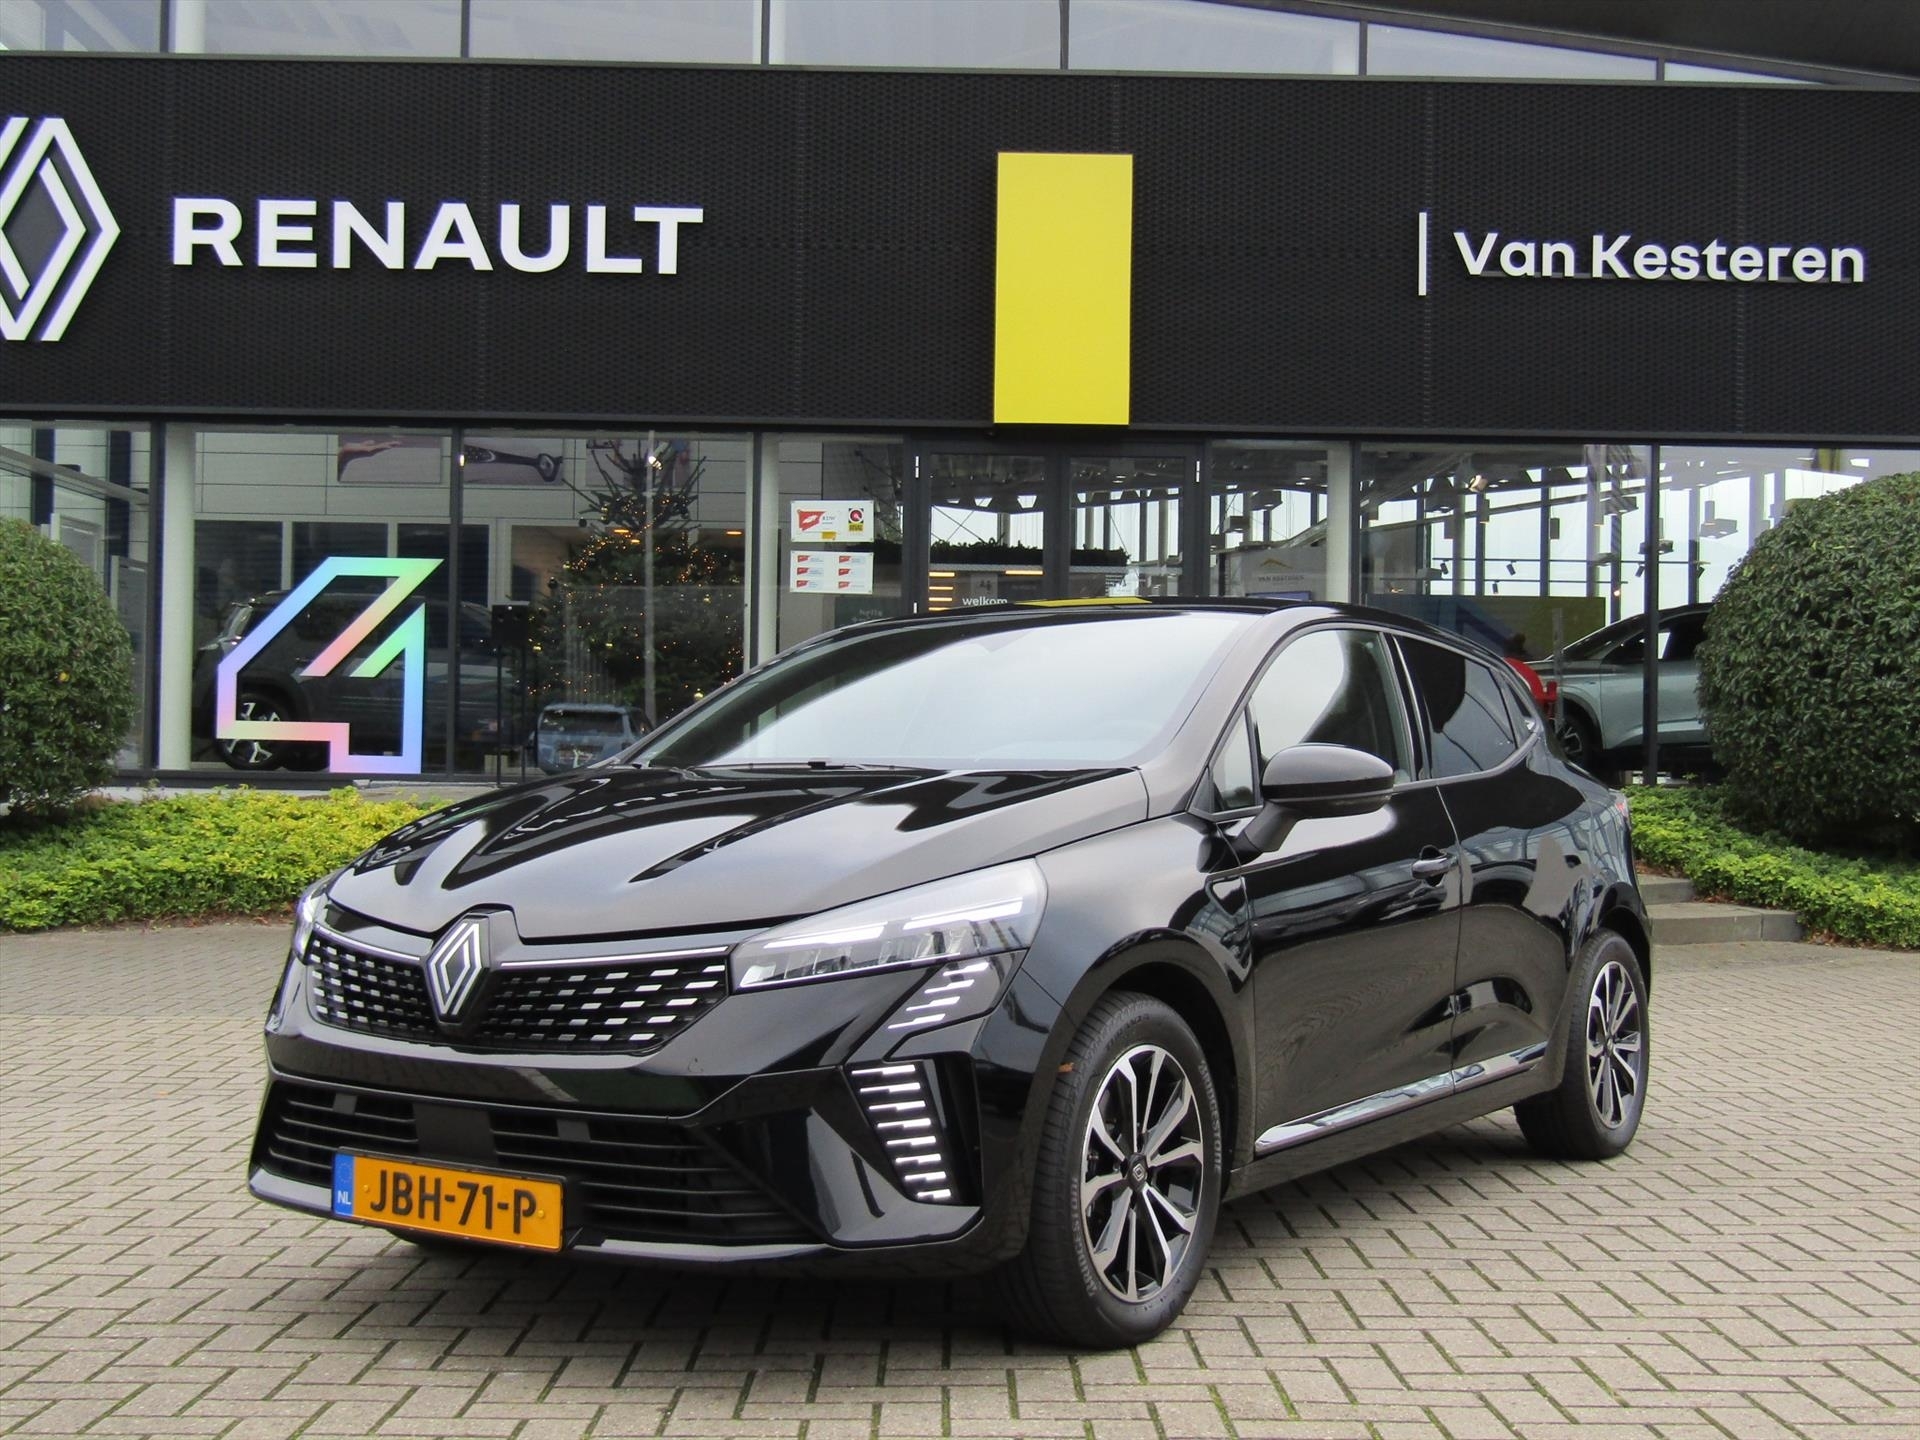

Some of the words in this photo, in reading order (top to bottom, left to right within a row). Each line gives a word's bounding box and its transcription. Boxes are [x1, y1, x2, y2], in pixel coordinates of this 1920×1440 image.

[172, 197, 704, 275] RENAULT
[1453, 231, 1576, 277] Van
[1592, 234, 1865, 284] Kesteren
[962, 596, 1008, 606] welkom
[337, 1191, 352, 1206] NL
[370, 1169, 538, 1235] JBH-71-P
